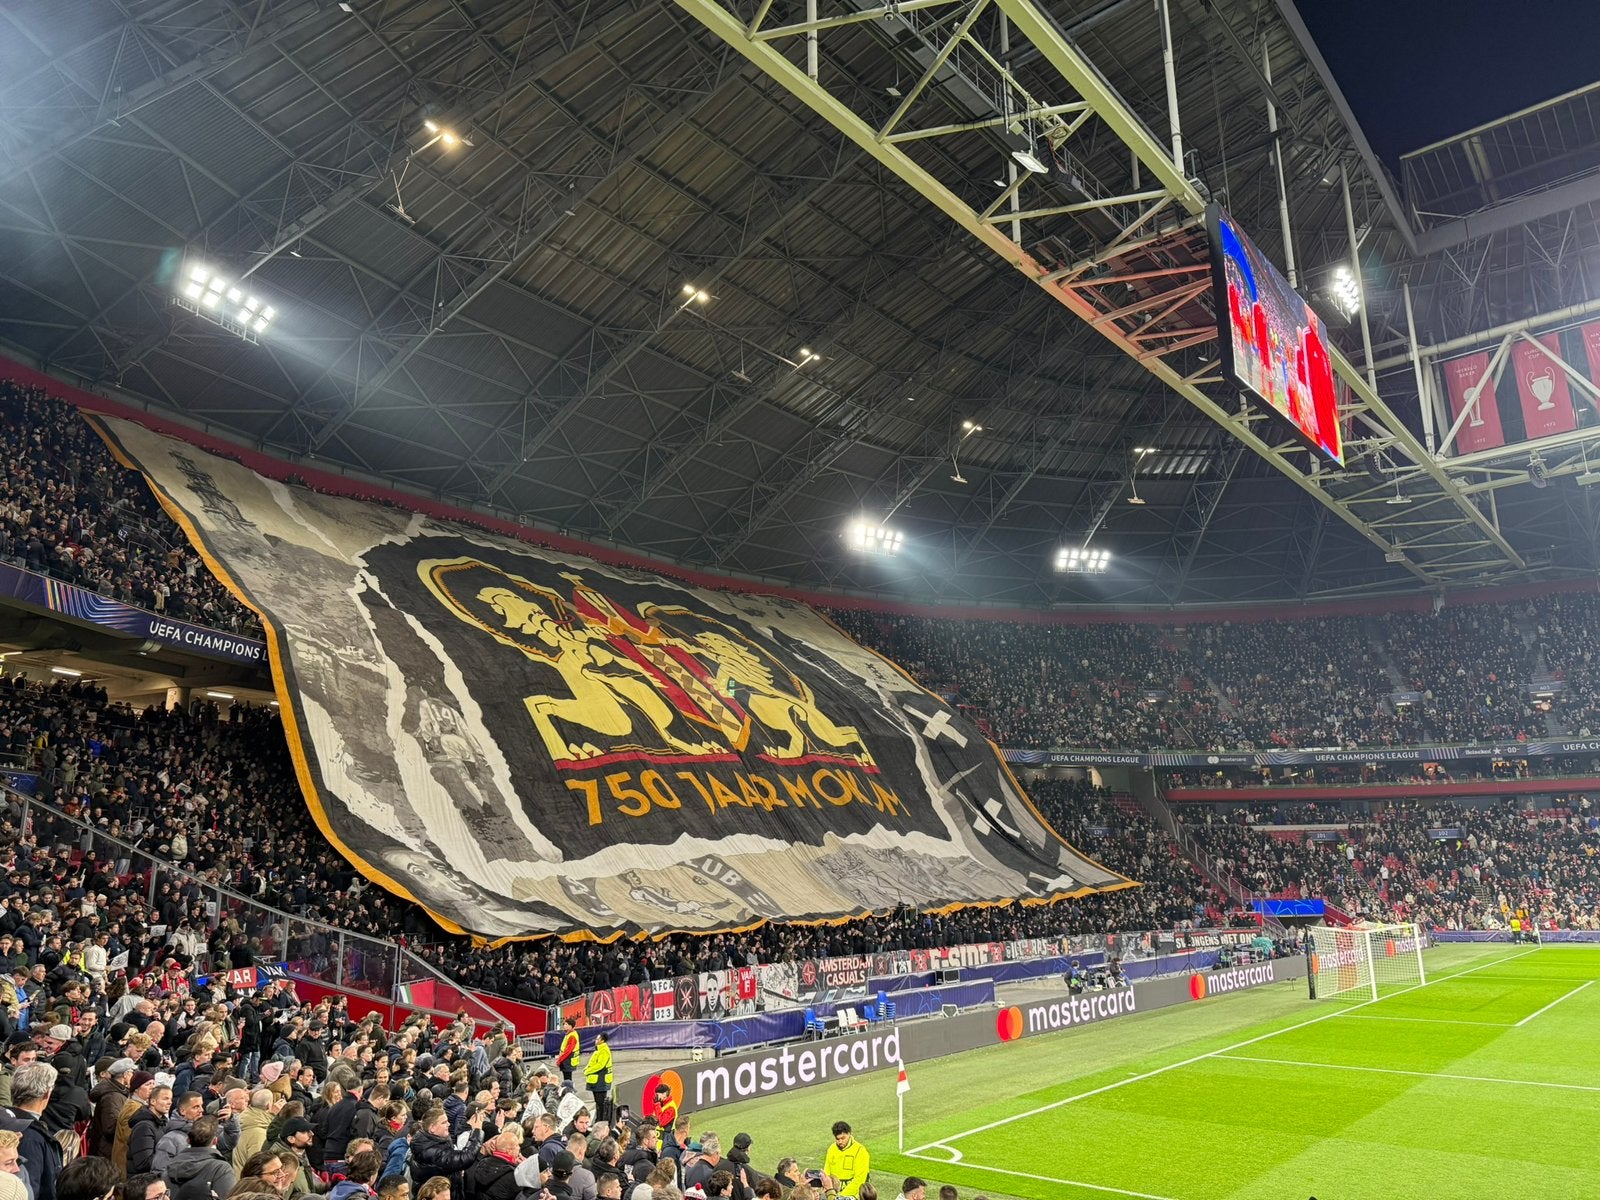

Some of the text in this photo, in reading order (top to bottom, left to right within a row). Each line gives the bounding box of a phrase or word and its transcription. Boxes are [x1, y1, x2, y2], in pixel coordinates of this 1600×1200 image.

[150, 620, 181, 641] UEFA
[185, 631, 260, 659] CHAMPIONS
[431, 703, 456, 726] 14
[1386, 751, 1420, 759] LEAGUE
[1562, 743, 1588, 751] UEFA
[1051, 754, 1069, 762] UEFA
[1070, 755, 1112, 763] CHAMPIONS
[564, 769, 682, 826] 750
[818, 956, 874, 973] AMSTERDAM
[1317, 948, 1364, 970] mastercard
[653, 979, 674, 992] AFCA
[826, 970, 866, 986] CASUALS
[1207, 962, 1274, 994] mastercard
[1028, 985, 1136, 1032] mastercard
[696, 1026, 900, 1105] mastercard
